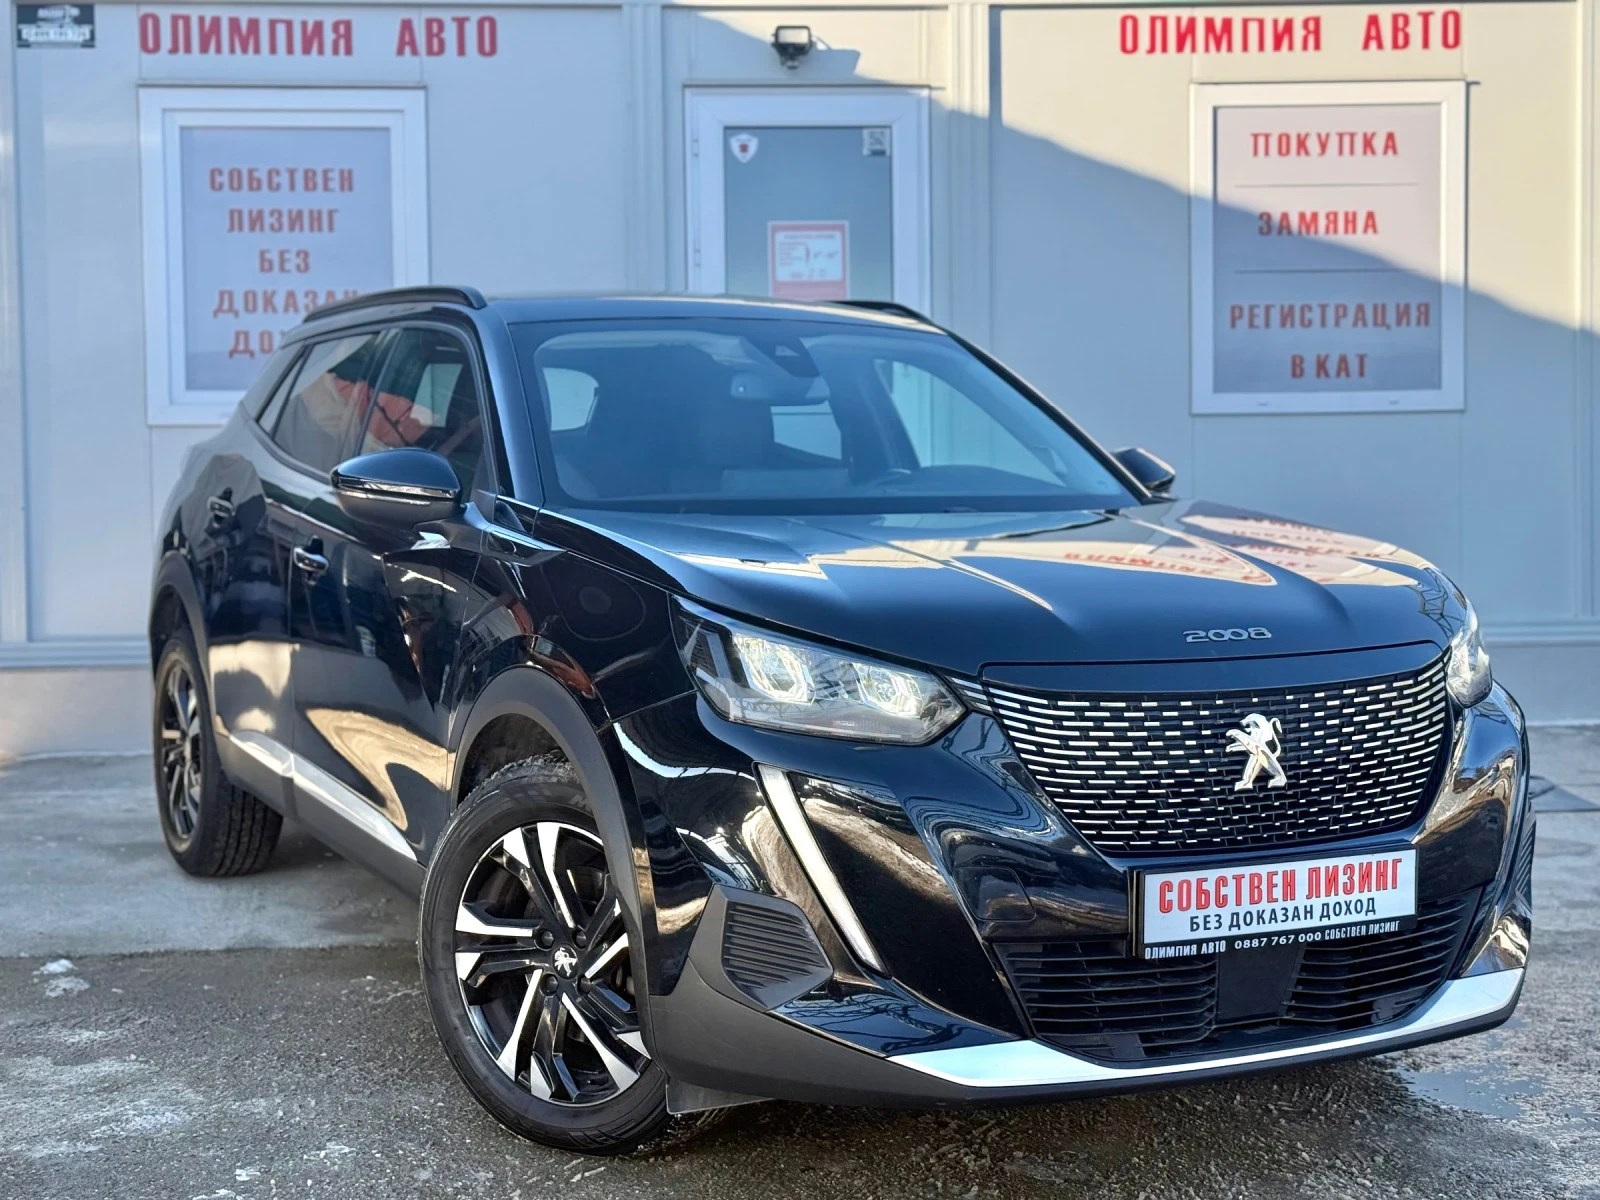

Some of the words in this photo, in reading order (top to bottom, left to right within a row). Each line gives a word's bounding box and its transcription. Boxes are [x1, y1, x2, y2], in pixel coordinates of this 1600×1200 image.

[139, 12, 353, 56] ОЛИМПИЯ
[395, 15, 498, 57] АВТО
[1119, 13, 1322, 55] ОЛИМПИЯ
[1362, 10, 1461, 50] АВТО
[1250, 132, 1398, 157] ПОКУПКА
[209, 168, 354, 193] СОБСТВЕН
[226, 208, 339, 233] ЛИЗИНГ
[1258, 211, 1379, 236] ЗАМЯНА
[258, 249, 311, 274] БЕЗ
[1229, 302, 1430, 331] РЕГИСТРАЦИЯ
[1291, 353, 1304, 379] В
[1315, 353, 1367, 378] КАТ
[1182, 626, 1272, 643] 2008
[1159, 869, 1296, 914] СОБСТВЕН
[1306, 858, 1402, 900] ЛИЗИНГ
[1189, 914, 1223, 932] БЕЗ
[1228, 905, 1314, 931] ДОКАЗАН
[1319, 897, 1376, 922] ДОХОД
[1144, 944, 1197, 960] ОЛИМПИЯ
[1200, 940, 1226, 955] АВТО
[1234, 938, 1267, 949] 0887
[1271, 935, 1295, 946] 767
[1298, 931, 1322, 943] 000
[1324, 925, 1366, 940] СОБСТВЕН
[1368, 920, 1401, 935] ЛИЗИНГ
